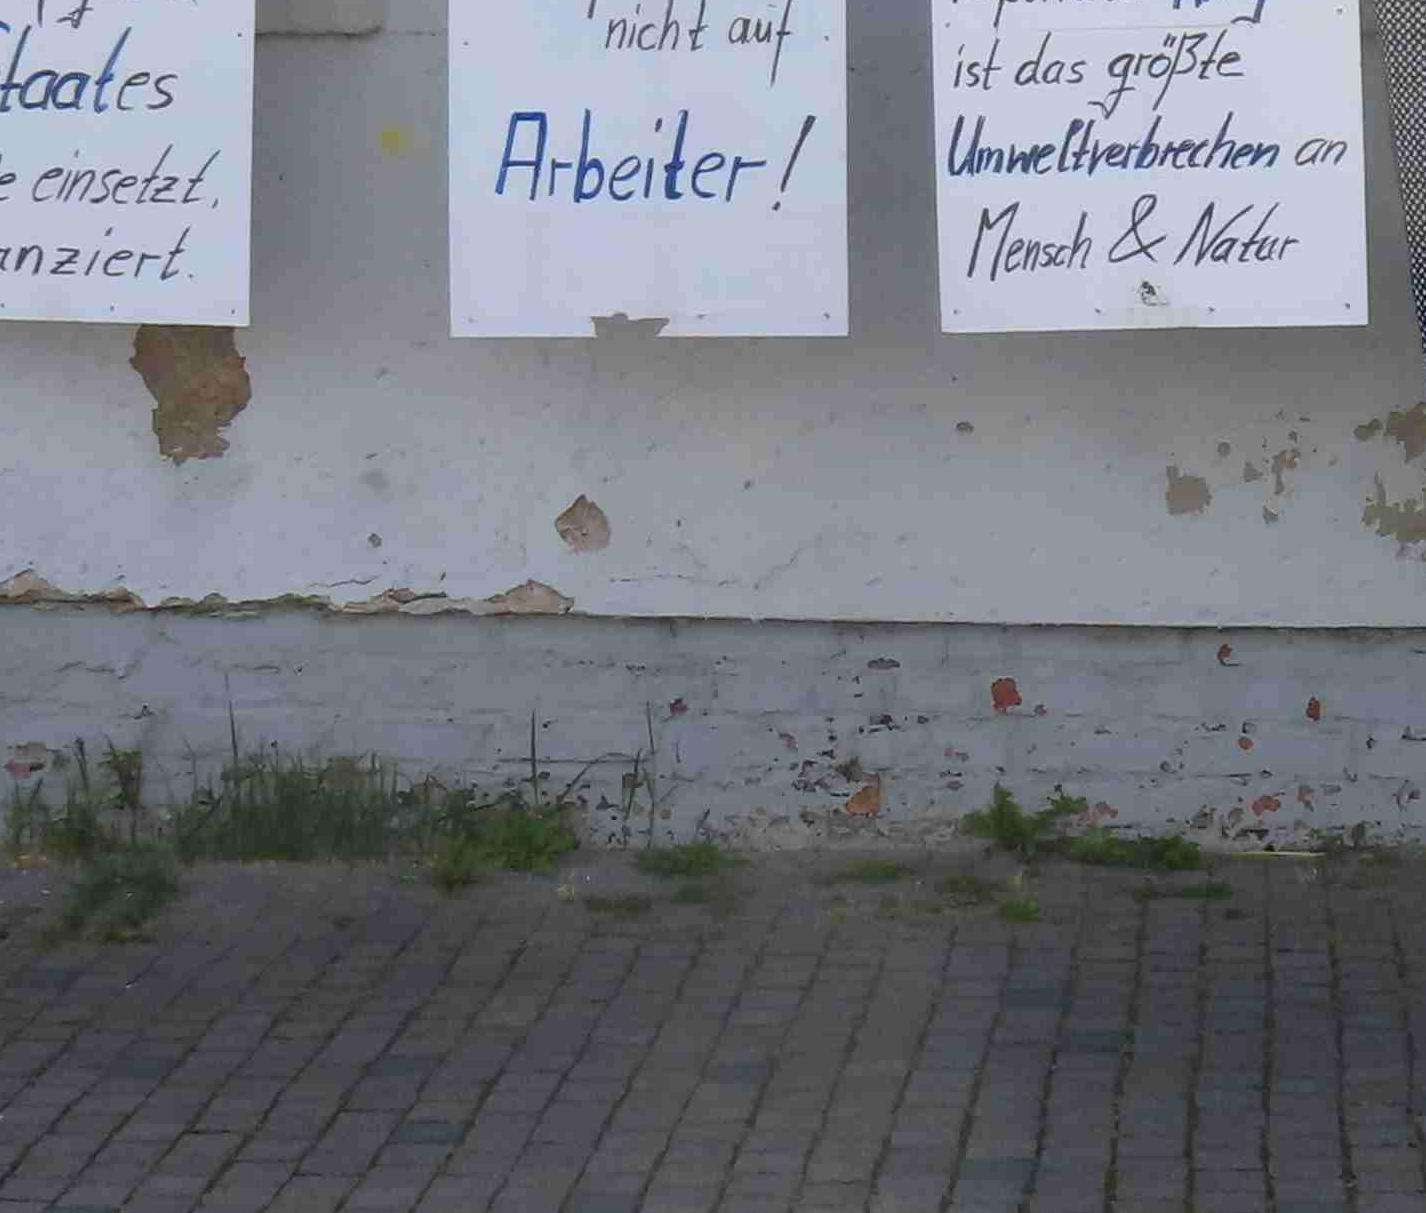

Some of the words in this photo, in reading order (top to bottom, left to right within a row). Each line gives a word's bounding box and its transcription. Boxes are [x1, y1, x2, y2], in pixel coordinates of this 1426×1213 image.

[953, 43, 1002, 91] ist
[1014, 31, 1085, 88] das
[1088, 29, 1246, 120] größte
[947, 111, 1280, 178] Umweltverbrechen
[1294, 136, 1349, 167] an
[967, 200, 1092, 282] Mensch
[1108, 193, 1168, 264] &
[1173, 202, 1302, 267] Natur
